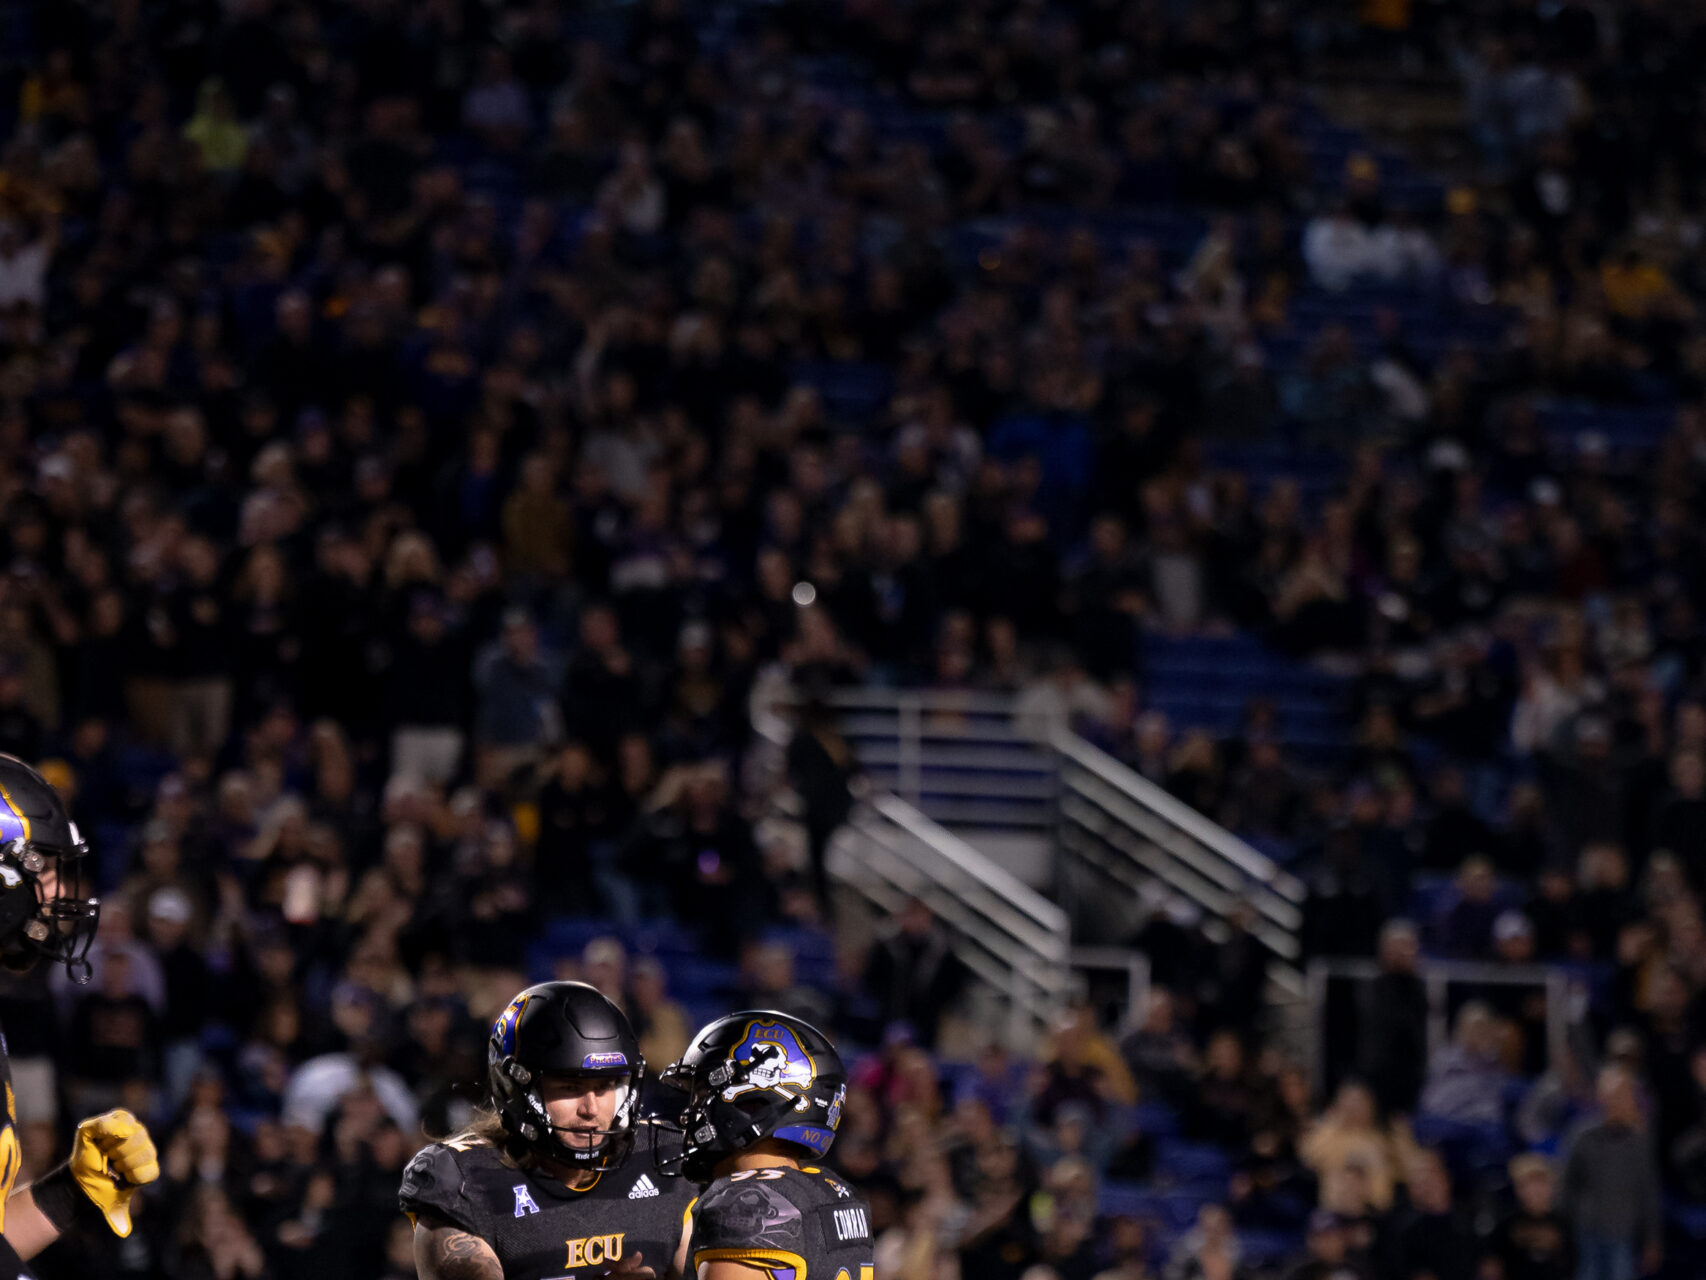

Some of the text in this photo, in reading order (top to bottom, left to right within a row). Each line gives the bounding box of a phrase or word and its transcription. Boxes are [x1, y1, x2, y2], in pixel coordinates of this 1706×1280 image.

[753, 1029, 785, 1039] ECU
[800, 1129, 820, 1143] NO
[628, 1187, 660, 1200] adidas
[833, 1208, 869, 1241] CONRAD
[564, 1233, 625, 1269] ECU
